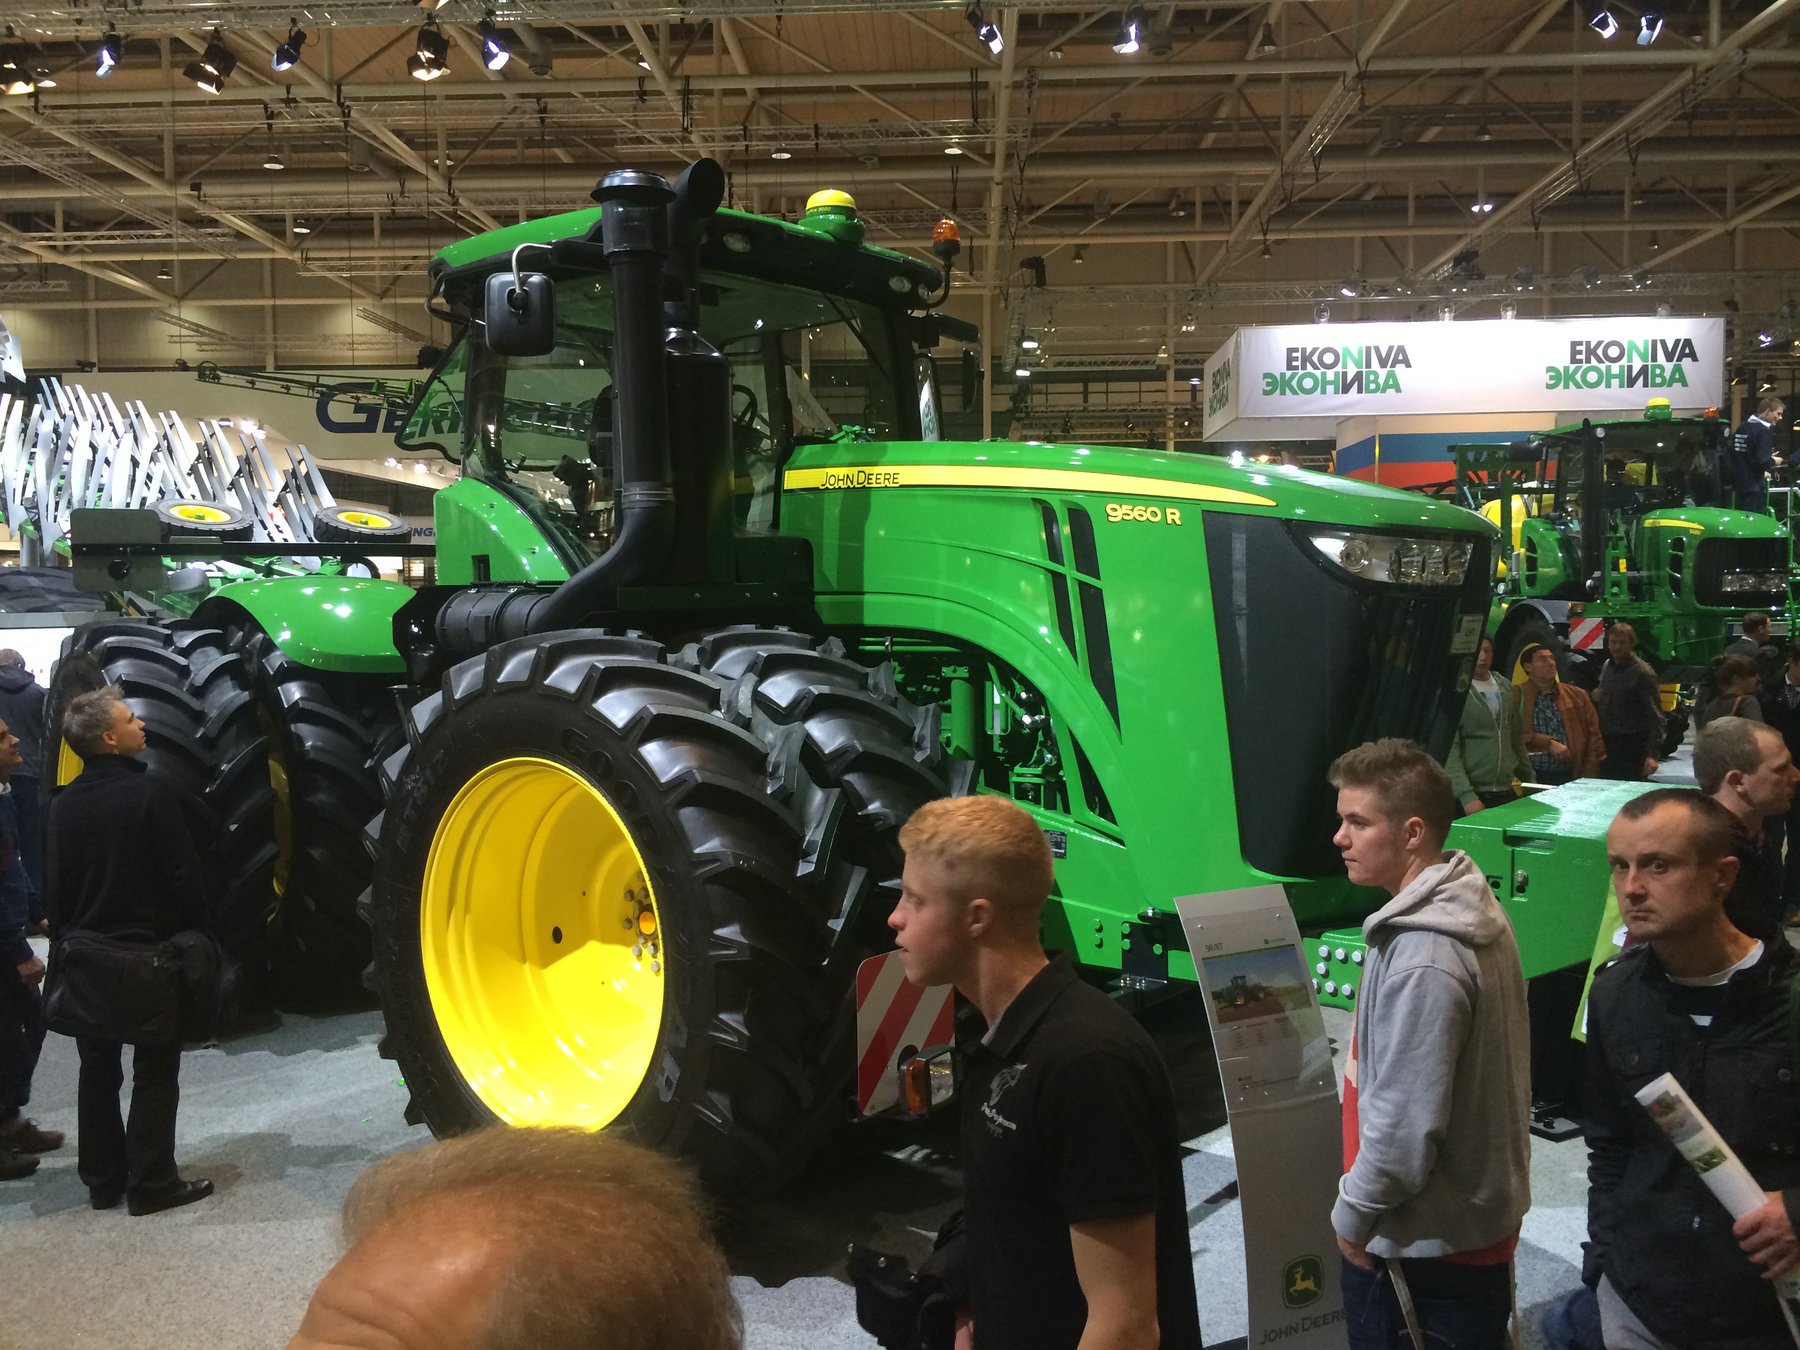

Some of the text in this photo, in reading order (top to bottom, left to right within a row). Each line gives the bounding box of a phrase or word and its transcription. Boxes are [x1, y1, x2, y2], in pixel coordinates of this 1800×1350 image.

[1286, 345, 1412, 371] EKONIVA
[1570, 338, 1699, 365] EKONIVA
[1262, 369, 1403, 396] ЭКОНИВА
[1545, 363, 1689, 390] ЭКОНИВА
[821, 470, 900, 487] JOHN DEERE
[1105, 503, 1182, 526] 9560 R
[1259, 1322, 1299, 1345] JOHN
